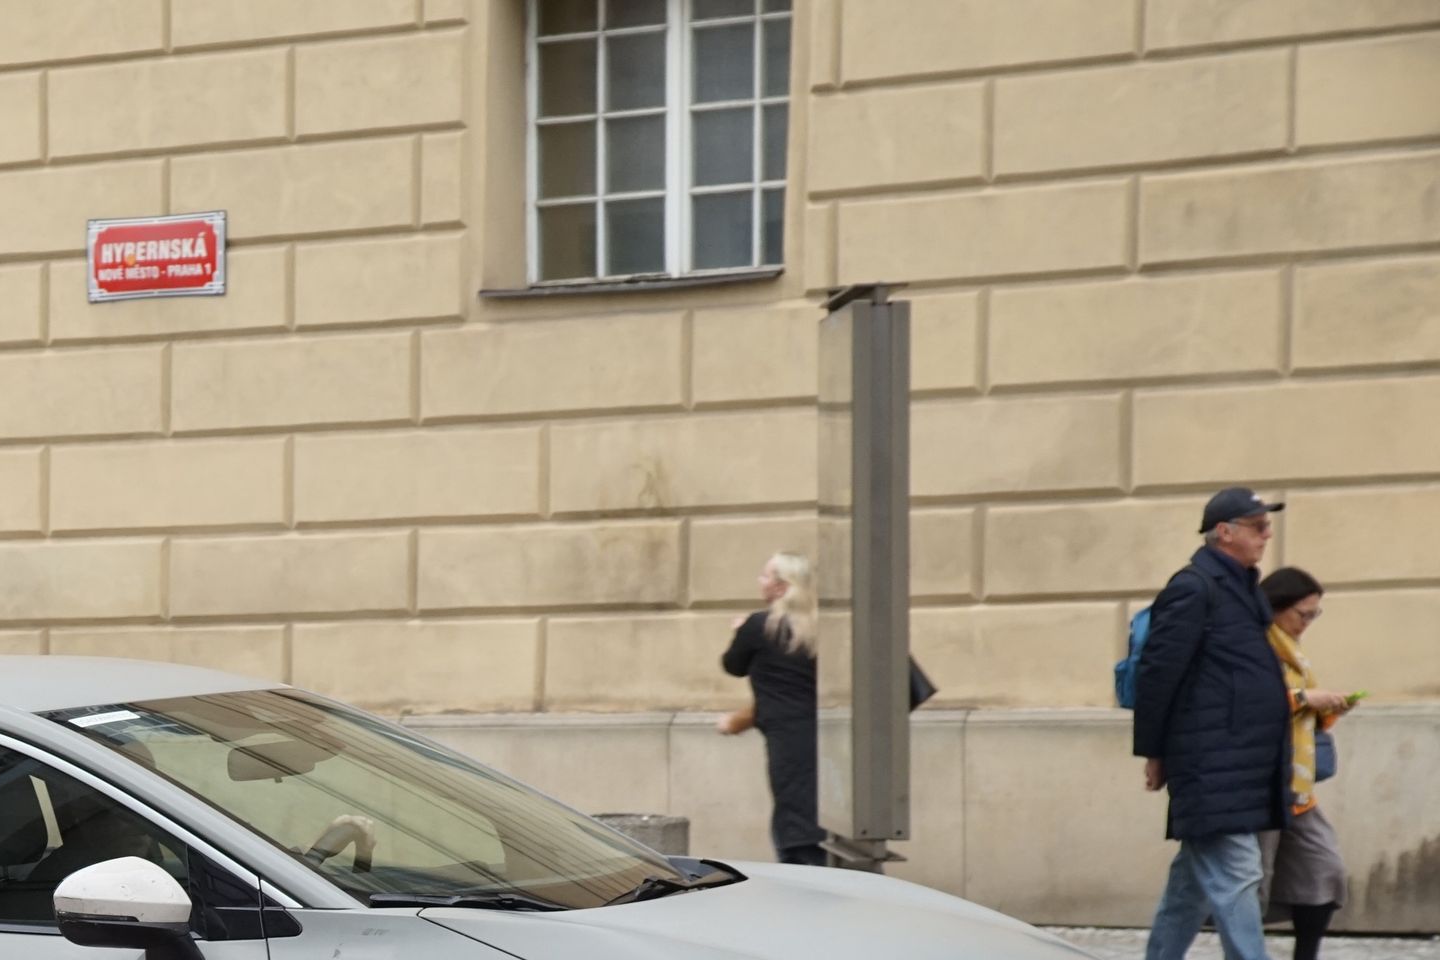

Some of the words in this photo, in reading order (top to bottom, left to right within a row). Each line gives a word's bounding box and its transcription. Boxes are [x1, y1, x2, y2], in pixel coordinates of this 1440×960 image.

[101, 232, 208, 264] HYBERNSKÁ
[97, 265, 125, 282] NOVÉ
[166, 263, 203, 278] PRAHA
[204, 262, 212, 275] 1
